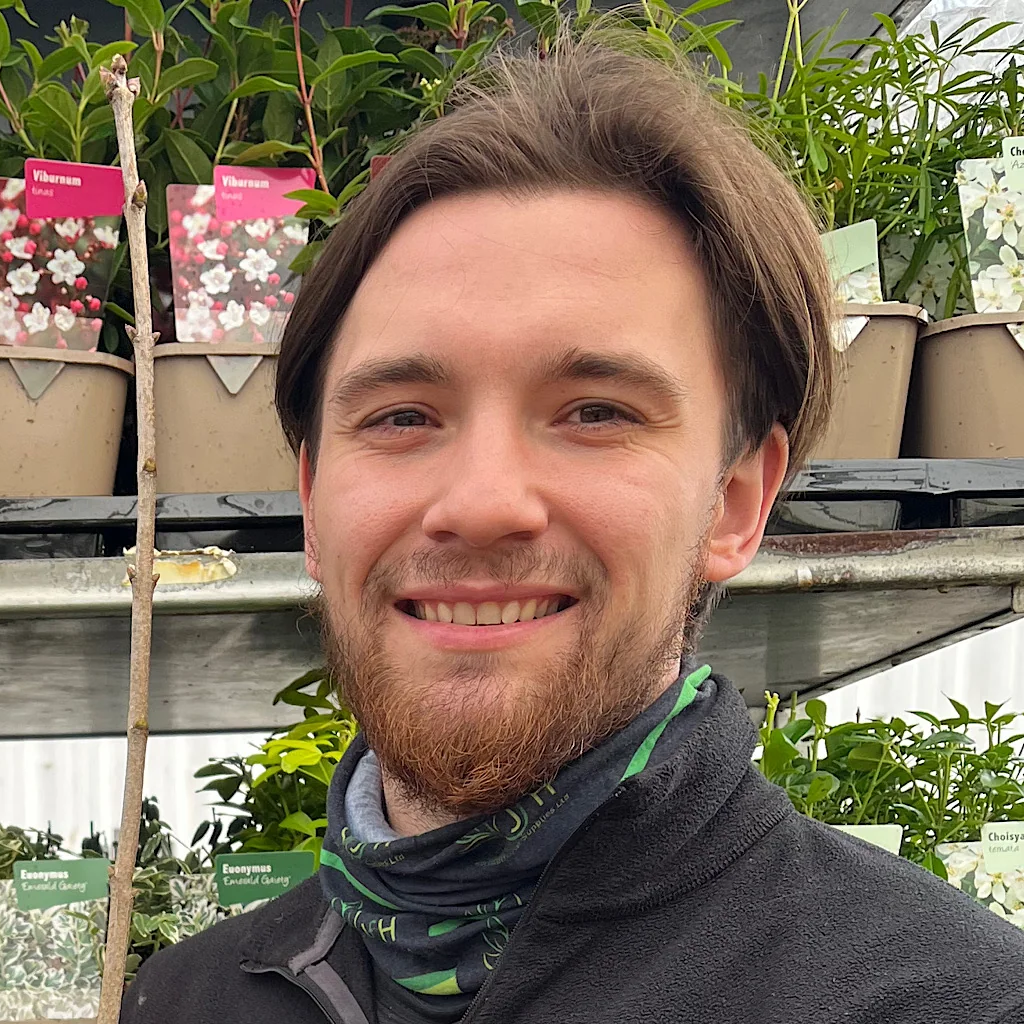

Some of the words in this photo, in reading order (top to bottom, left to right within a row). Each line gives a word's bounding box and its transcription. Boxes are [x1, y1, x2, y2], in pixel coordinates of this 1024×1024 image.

[33, 169, 81, 186] Viburnum
[222, 175, 269, 188] Viburnum
[21, 869, 68, 881] Euonymus
[222, 864, 271, 876] Euonymus
